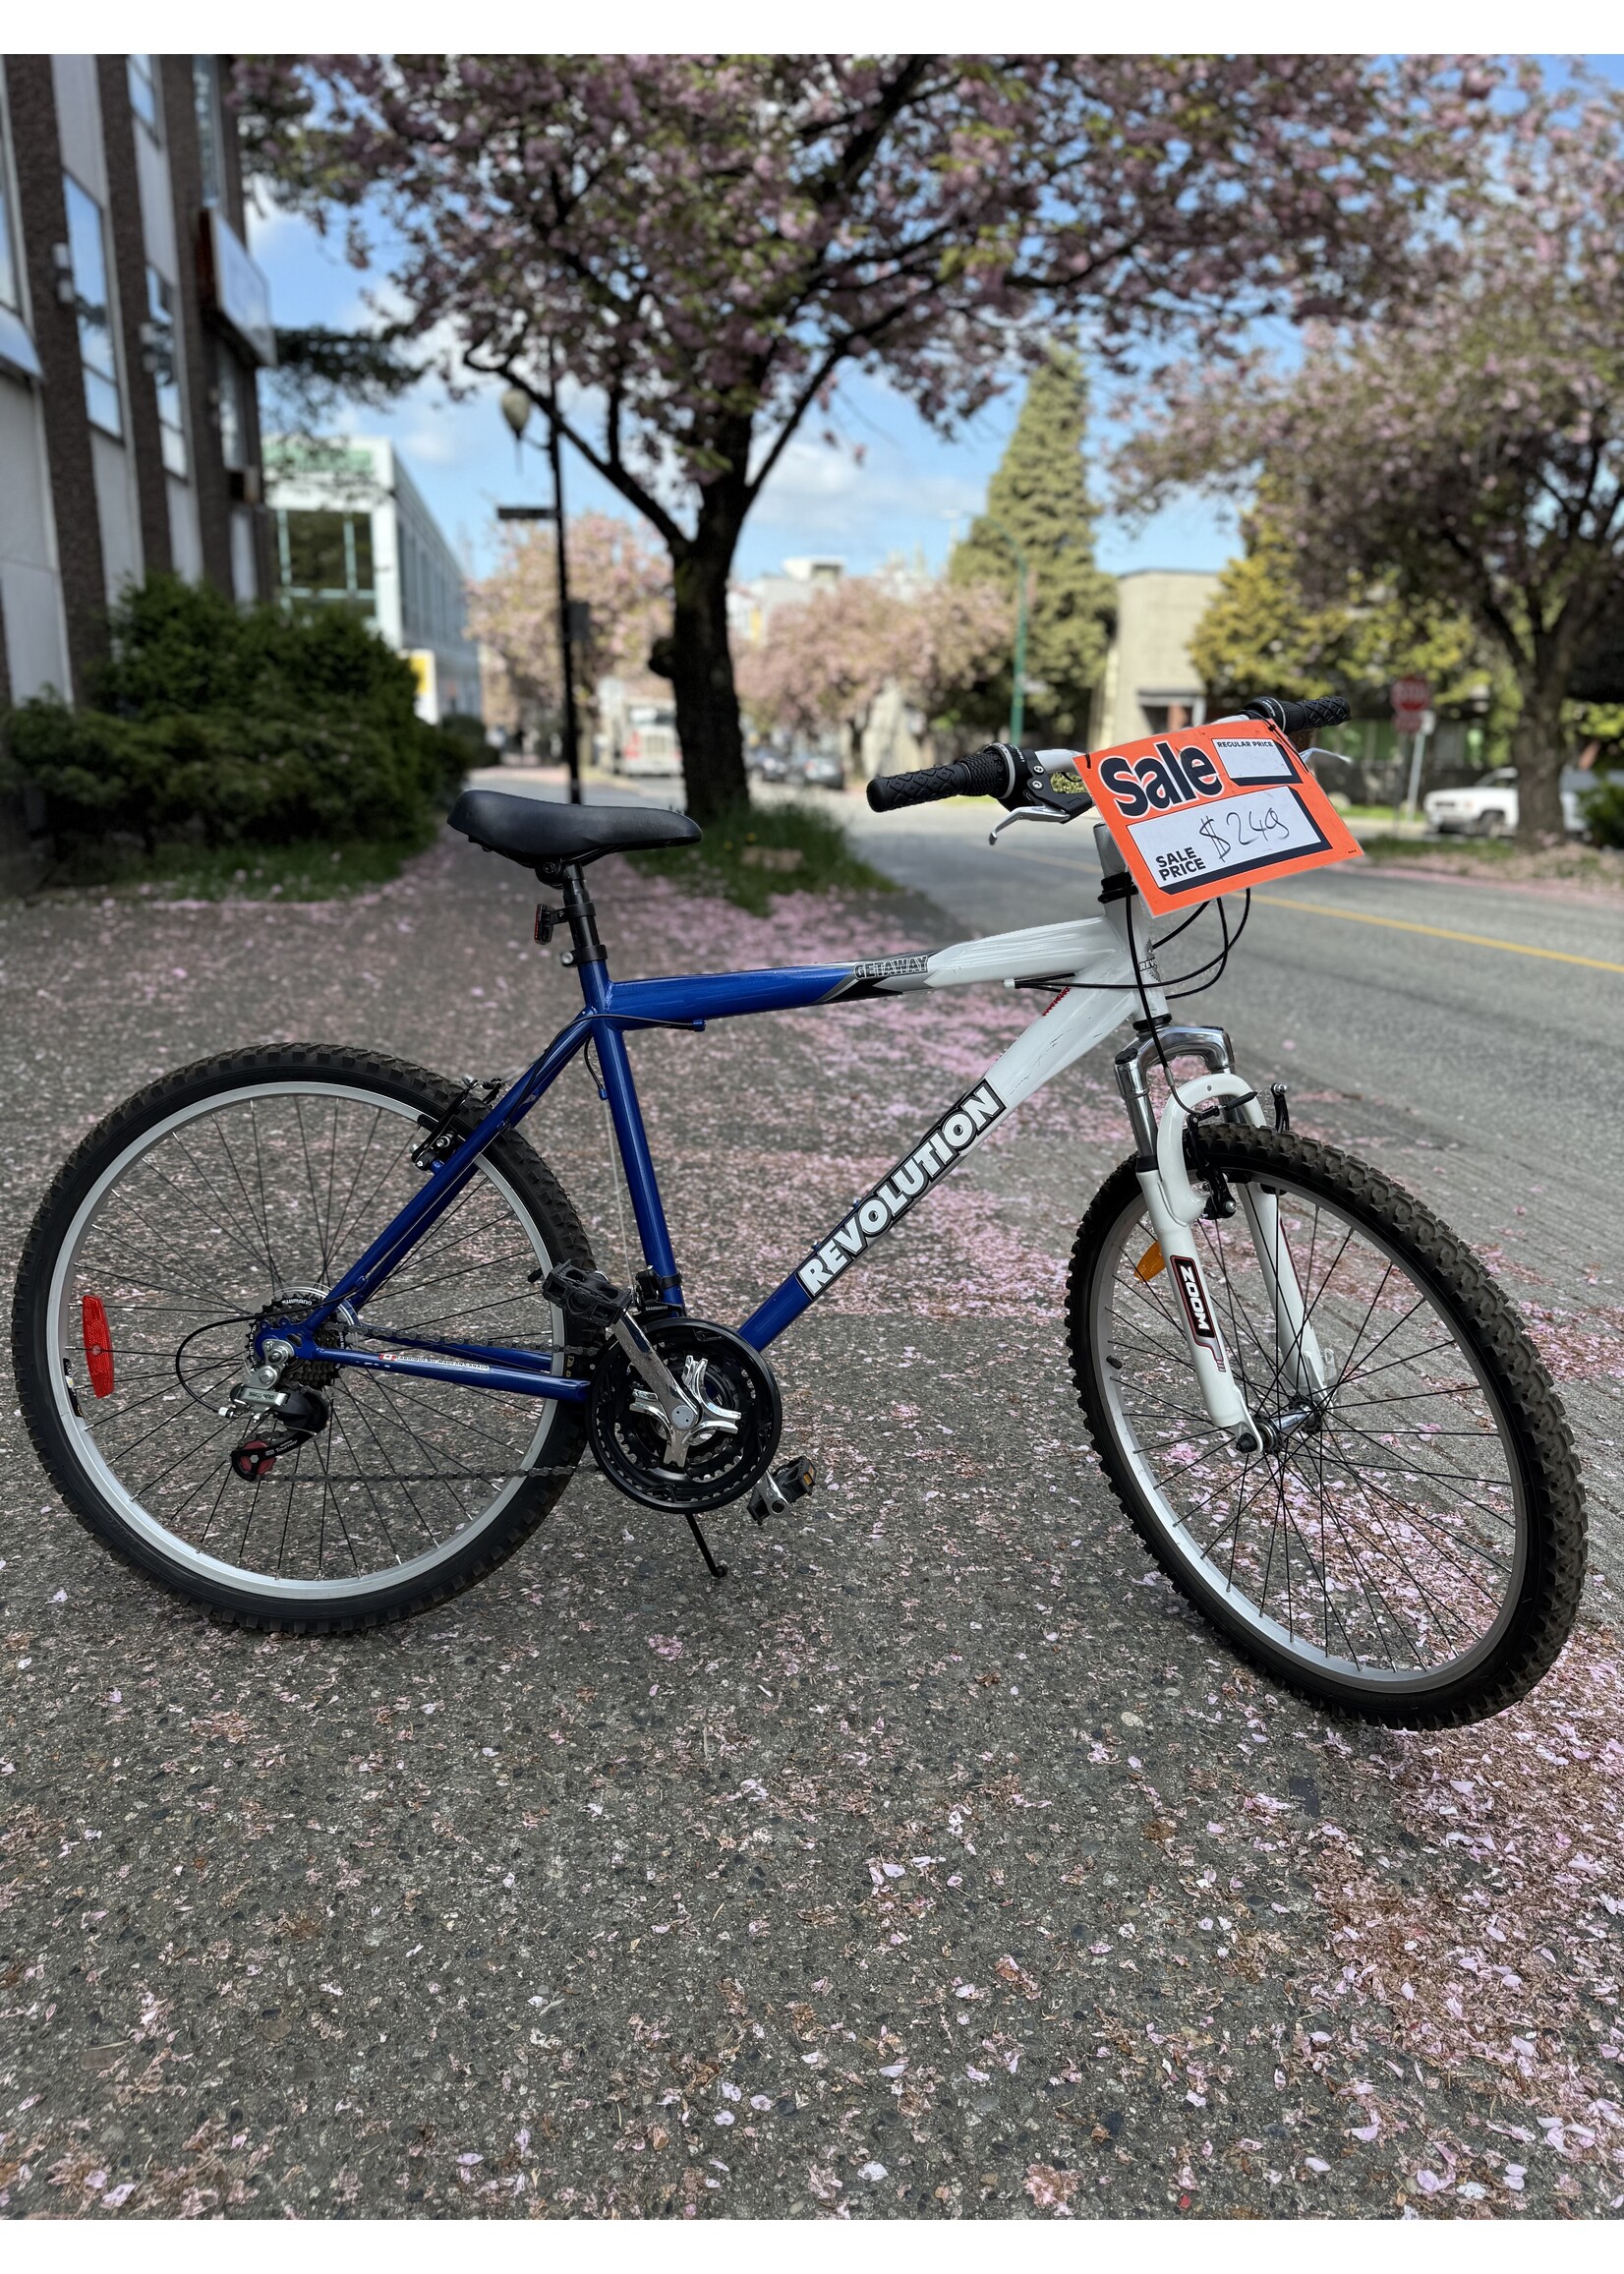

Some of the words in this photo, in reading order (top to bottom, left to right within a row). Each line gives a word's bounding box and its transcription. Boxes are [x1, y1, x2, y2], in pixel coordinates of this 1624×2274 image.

[1155, 846, 1197, 868] SALE
[1158, 857, 1206, 881] PRICE
[854, 955, 928, 980] GETAWAY
[797, 1082, 1001, 1297] REVOLUTION
[1180, 1265, 1210, 1330] ZOOM
